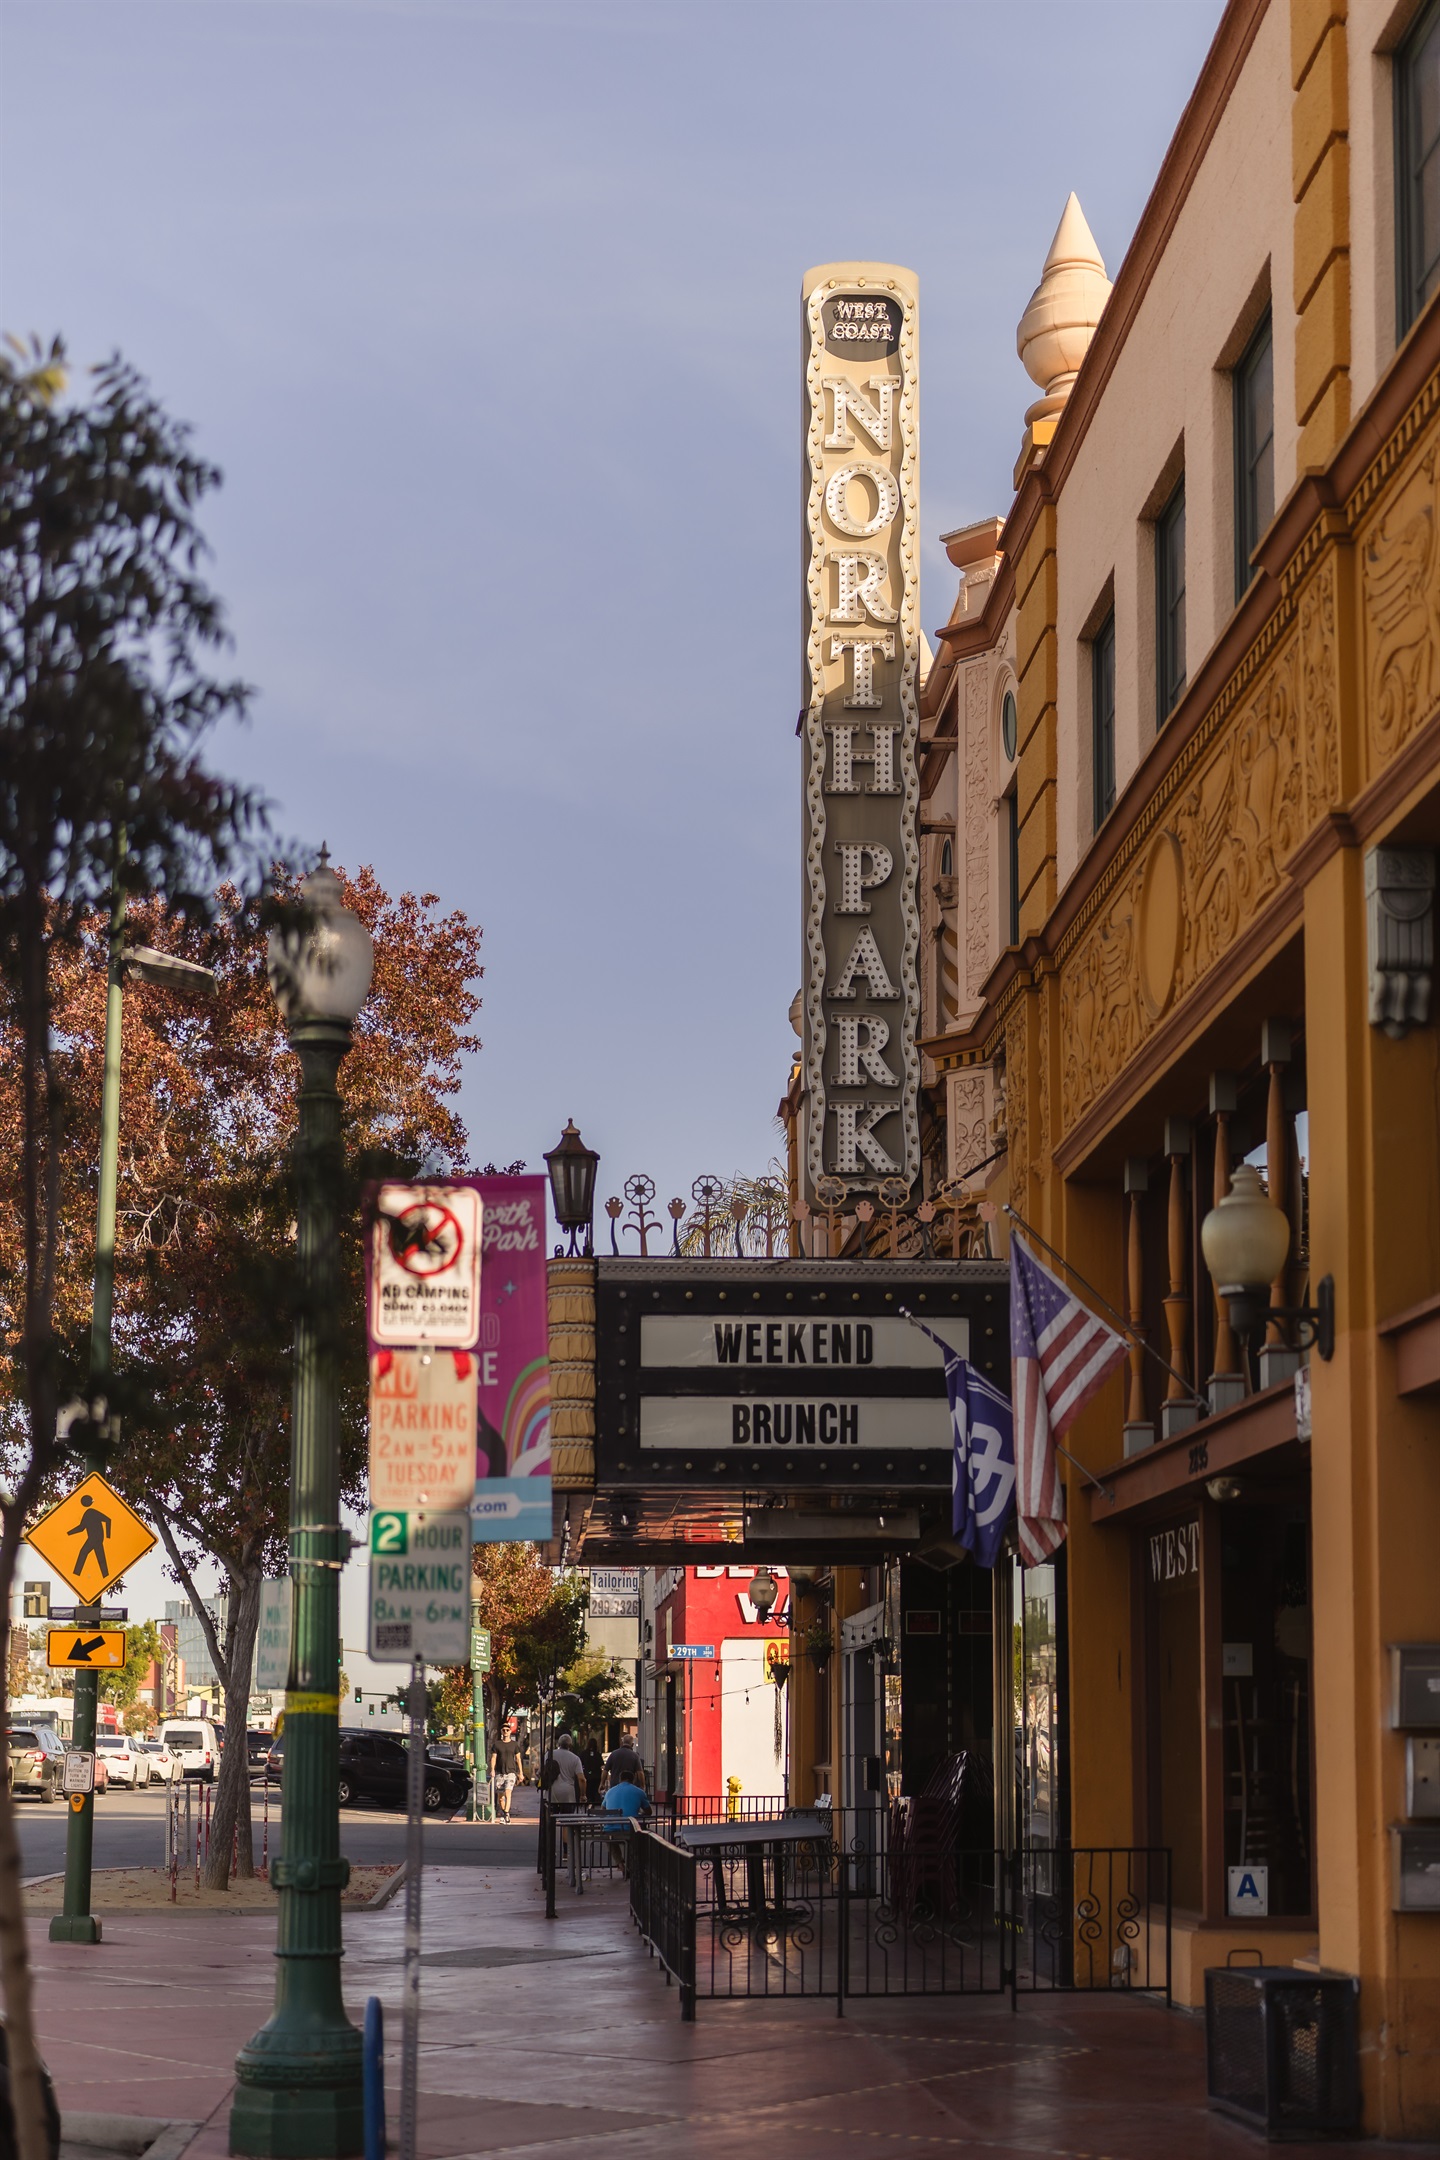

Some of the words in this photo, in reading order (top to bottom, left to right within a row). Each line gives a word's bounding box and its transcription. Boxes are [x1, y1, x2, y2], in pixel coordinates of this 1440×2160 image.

[836, 300, 890, 321] WEST
[830, 322, 895, 342] COAST
[822, 374, 902, 796] NORTH
[826, 839, 902, 1175] PARK
[483, 1199, 534, 1228] orth
[482, 1223, 540, 1252] Park
[382, 1284, 401, 1299] NO
[405, 1283, 470, 1300] CAMPING
[713, 1322, 874, 1366] WEEKEND
[380, 1402, 468, 1432] PARKING
[731, 1402, 859, 1445] BRUNCH
[386, 1461, 458, 1485] TUESDAY
[377, 1514, 403, 1551] 2
[414, 1525, 463, 1551] HOUR
[1149, 1521, 1200, 1583] WEST
[378, 1562, 463, 1593] PARKING
[592, 1572, 638, 1592] Tailoring
[676, 1646, 697, 1657] 29TH
[1236, 1873, 1260, 1898] A
